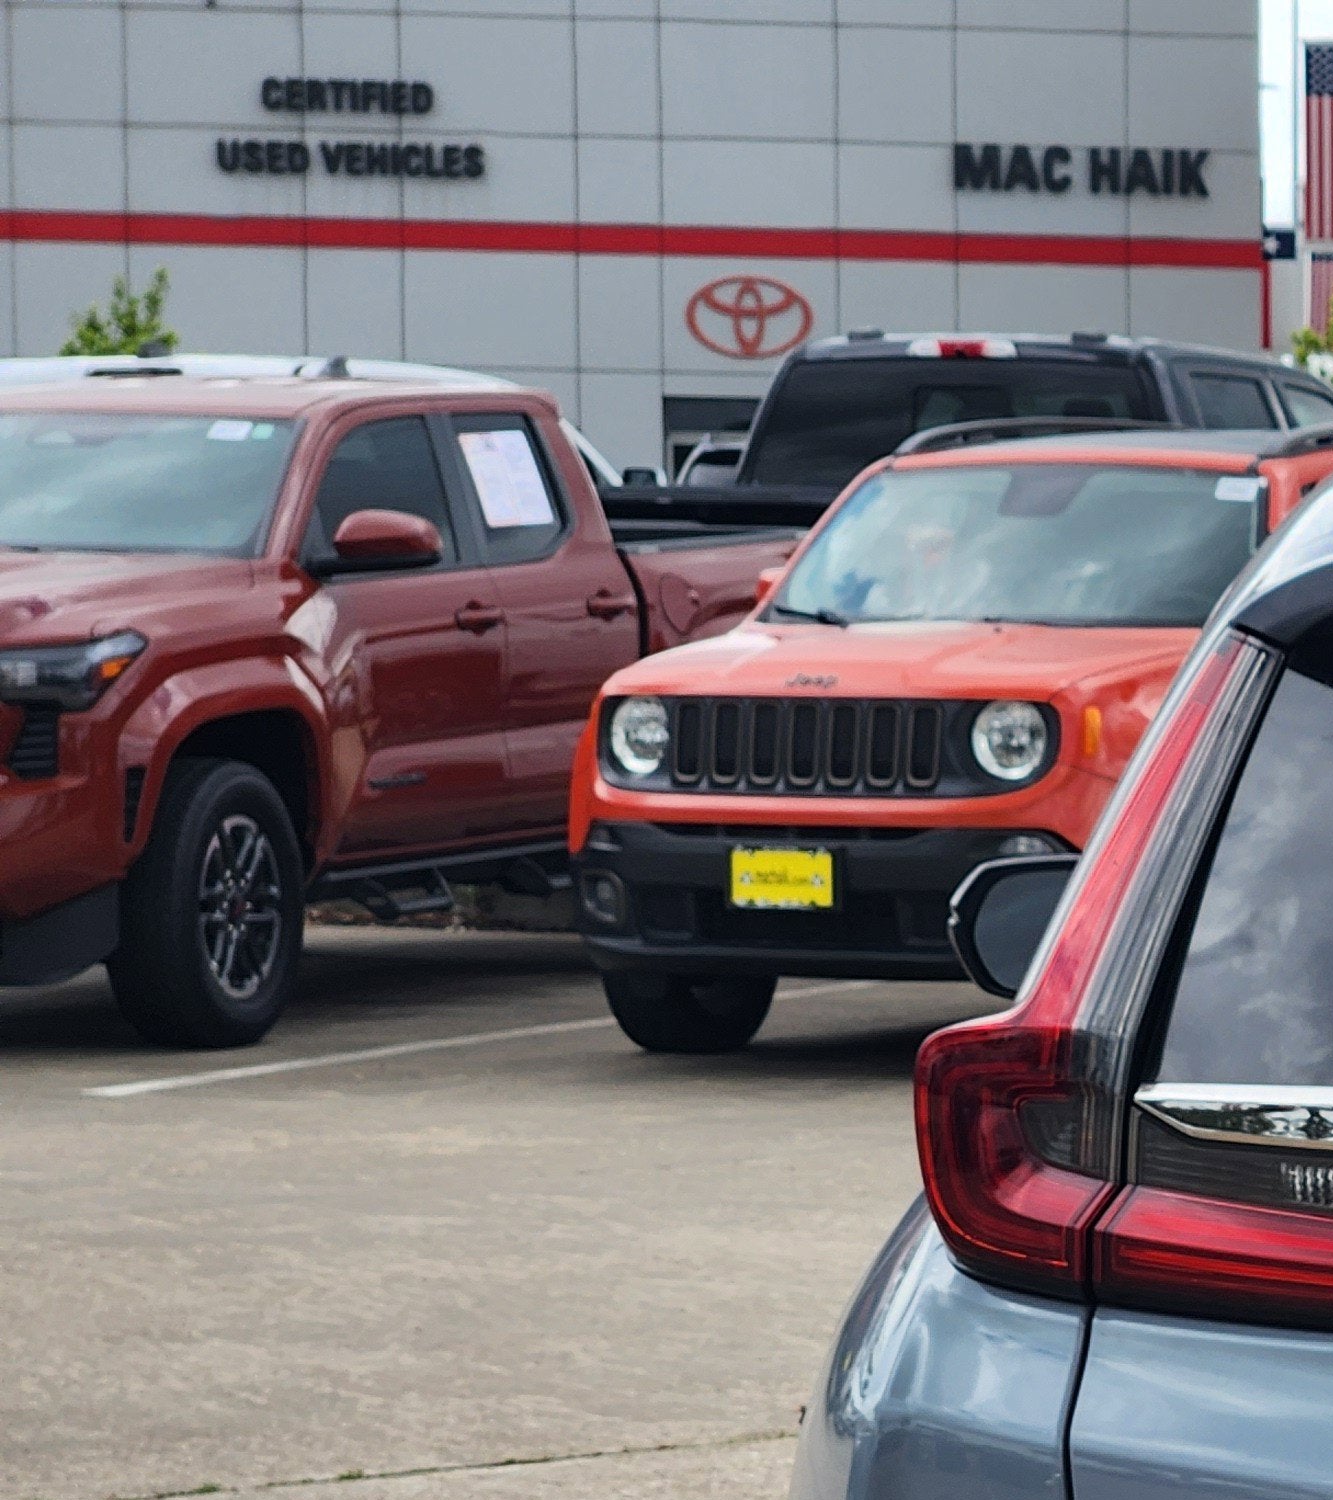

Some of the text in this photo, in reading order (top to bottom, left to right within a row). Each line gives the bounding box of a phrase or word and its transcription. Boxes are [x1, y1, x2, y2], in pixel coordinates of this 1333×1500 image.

[261, 77, 434, 114] CERTIFIED
[216, 138, 485, 177] USED VEHICLES
[954, 143, 1211, 198] MAC HAIK
[784, 671, 839, 689] Jeep
